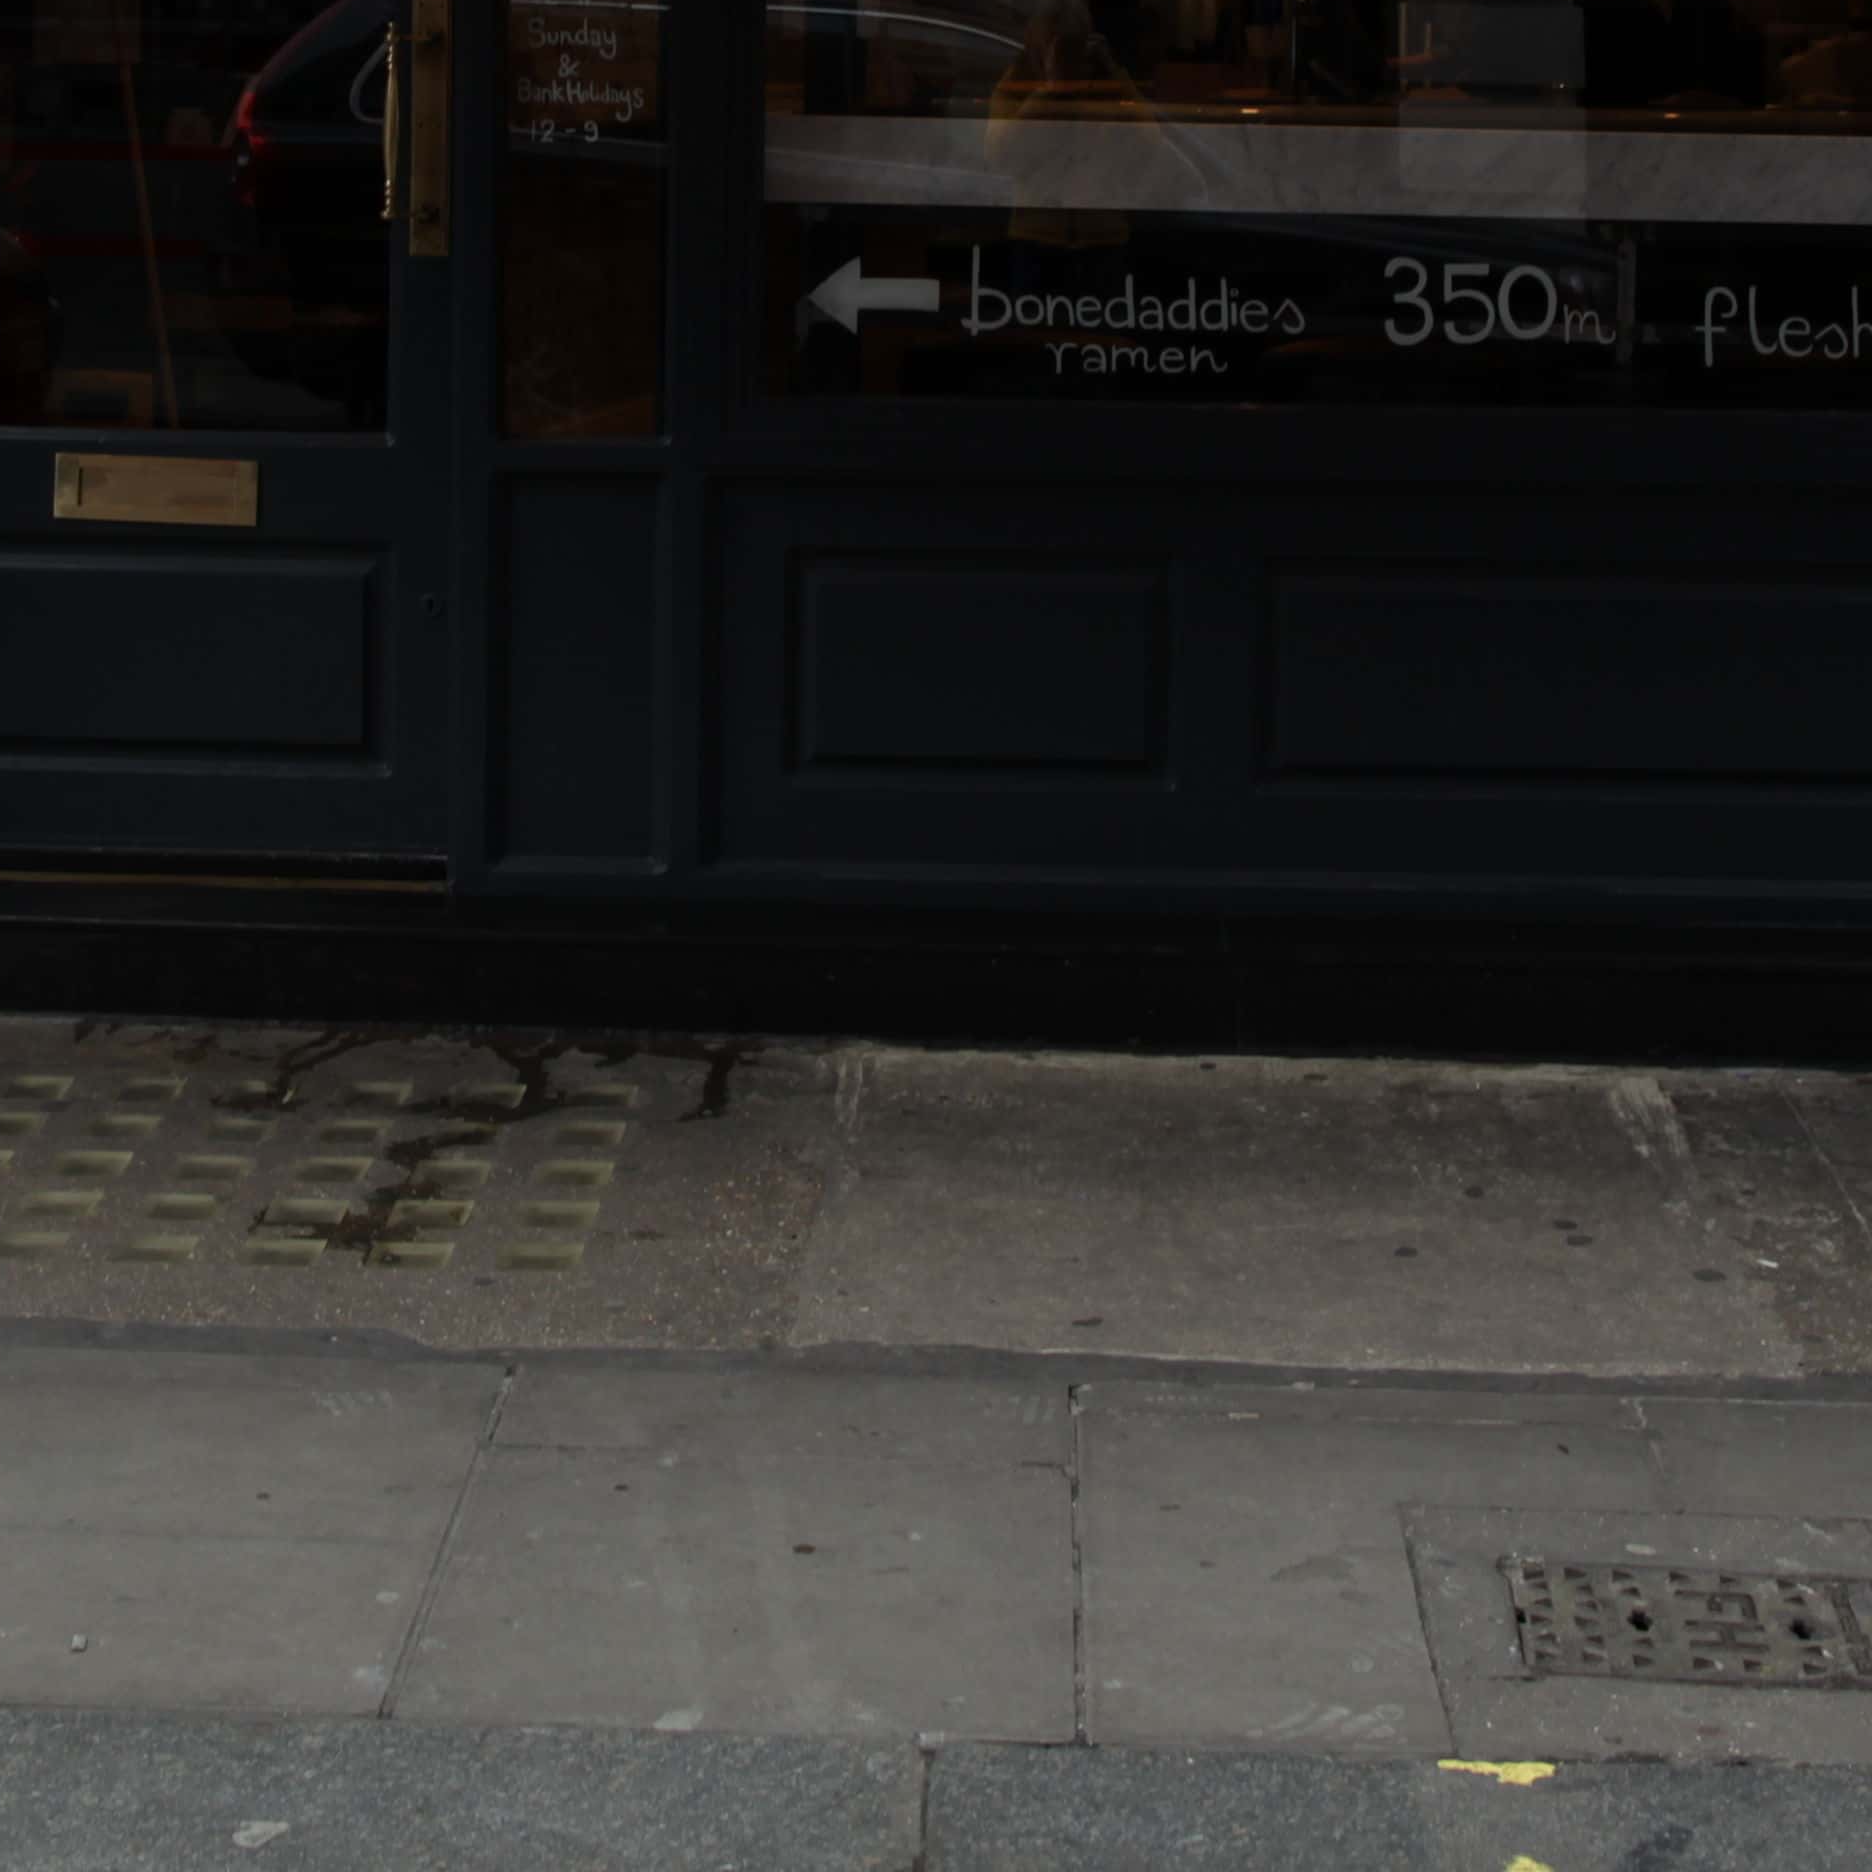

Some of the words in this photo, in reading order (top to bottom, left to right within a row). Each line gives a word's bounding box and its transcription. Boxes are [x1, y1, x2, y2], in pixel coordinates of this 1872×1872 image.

[527, 15, 618, 61] Sunday
[558, 53, 581, 78] &
[960, 244, 1306, 336] bonedaddies
[1046, 341, 1228, 376] ramen
